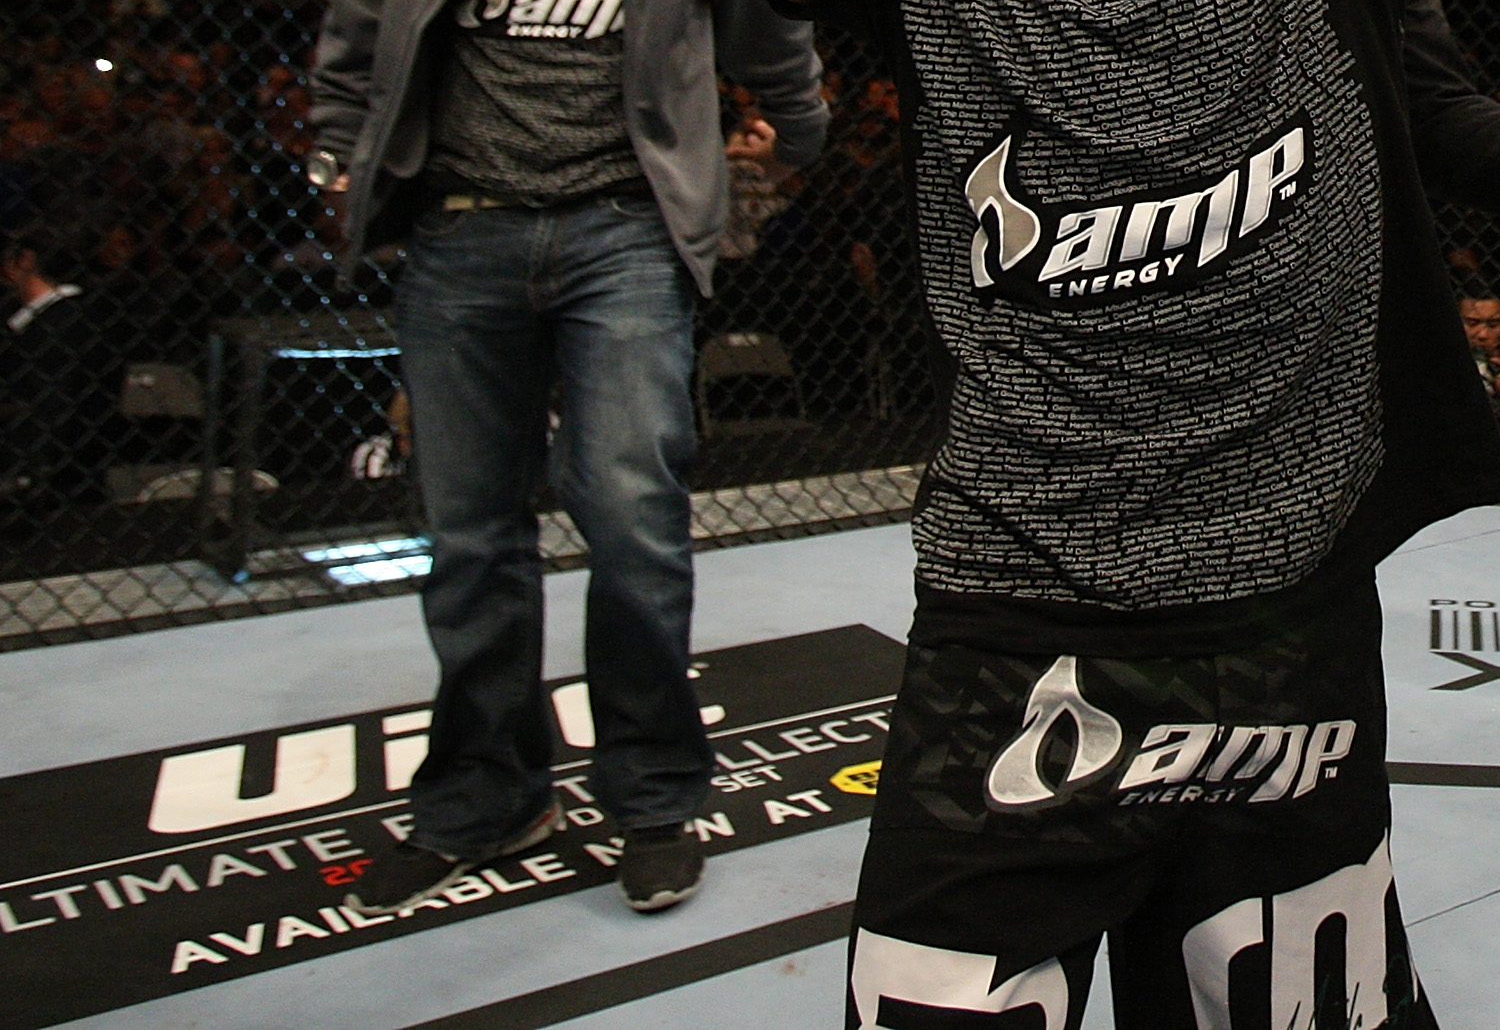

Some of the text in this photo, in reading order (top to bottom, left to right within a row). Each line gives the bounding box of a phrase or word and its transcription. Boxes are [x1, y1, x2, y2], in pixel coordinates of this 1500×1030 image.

[1048, 254, 1184, 300] ENERGY
[710, 764, 783, 793] SET
[763, 788, 833, 825] AT
